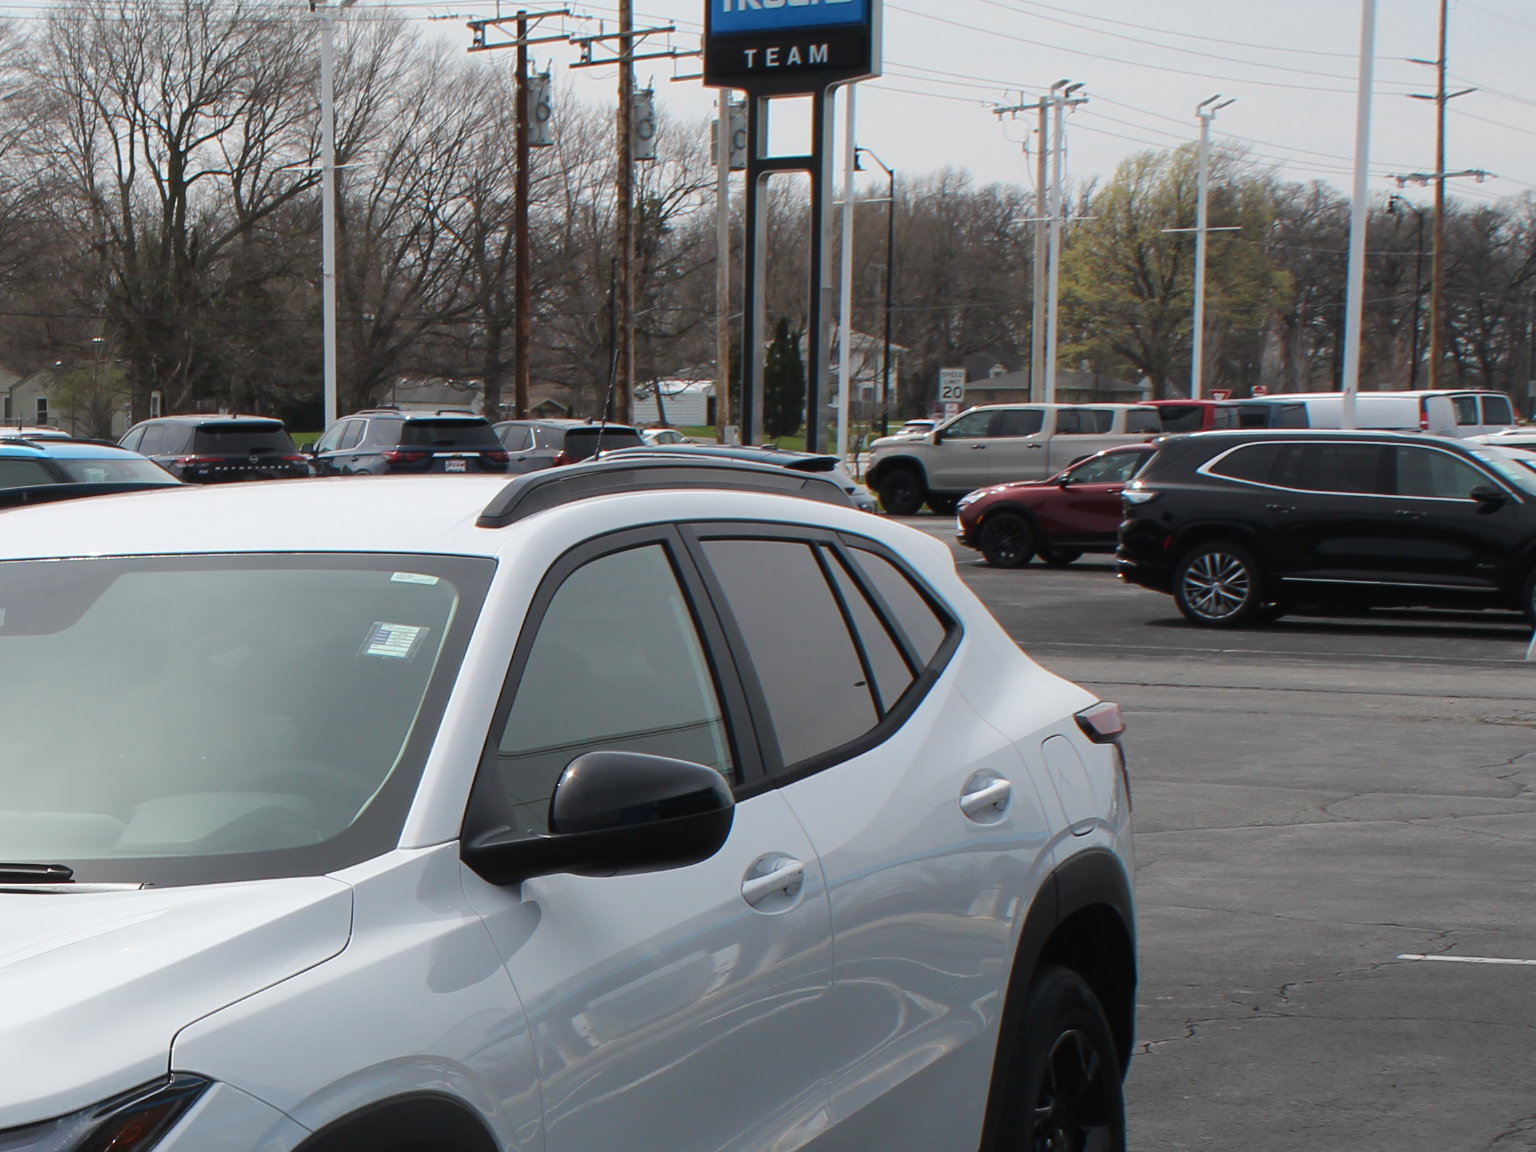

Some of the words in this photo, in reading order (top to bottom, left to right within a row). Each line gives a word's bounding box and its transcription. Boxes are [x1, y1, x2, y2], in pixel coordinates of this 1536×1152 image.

[744, 43, 829, 68] TEAM
[942, 370, 964, 378] SPEED
[942, 386, 962, 399] 20
